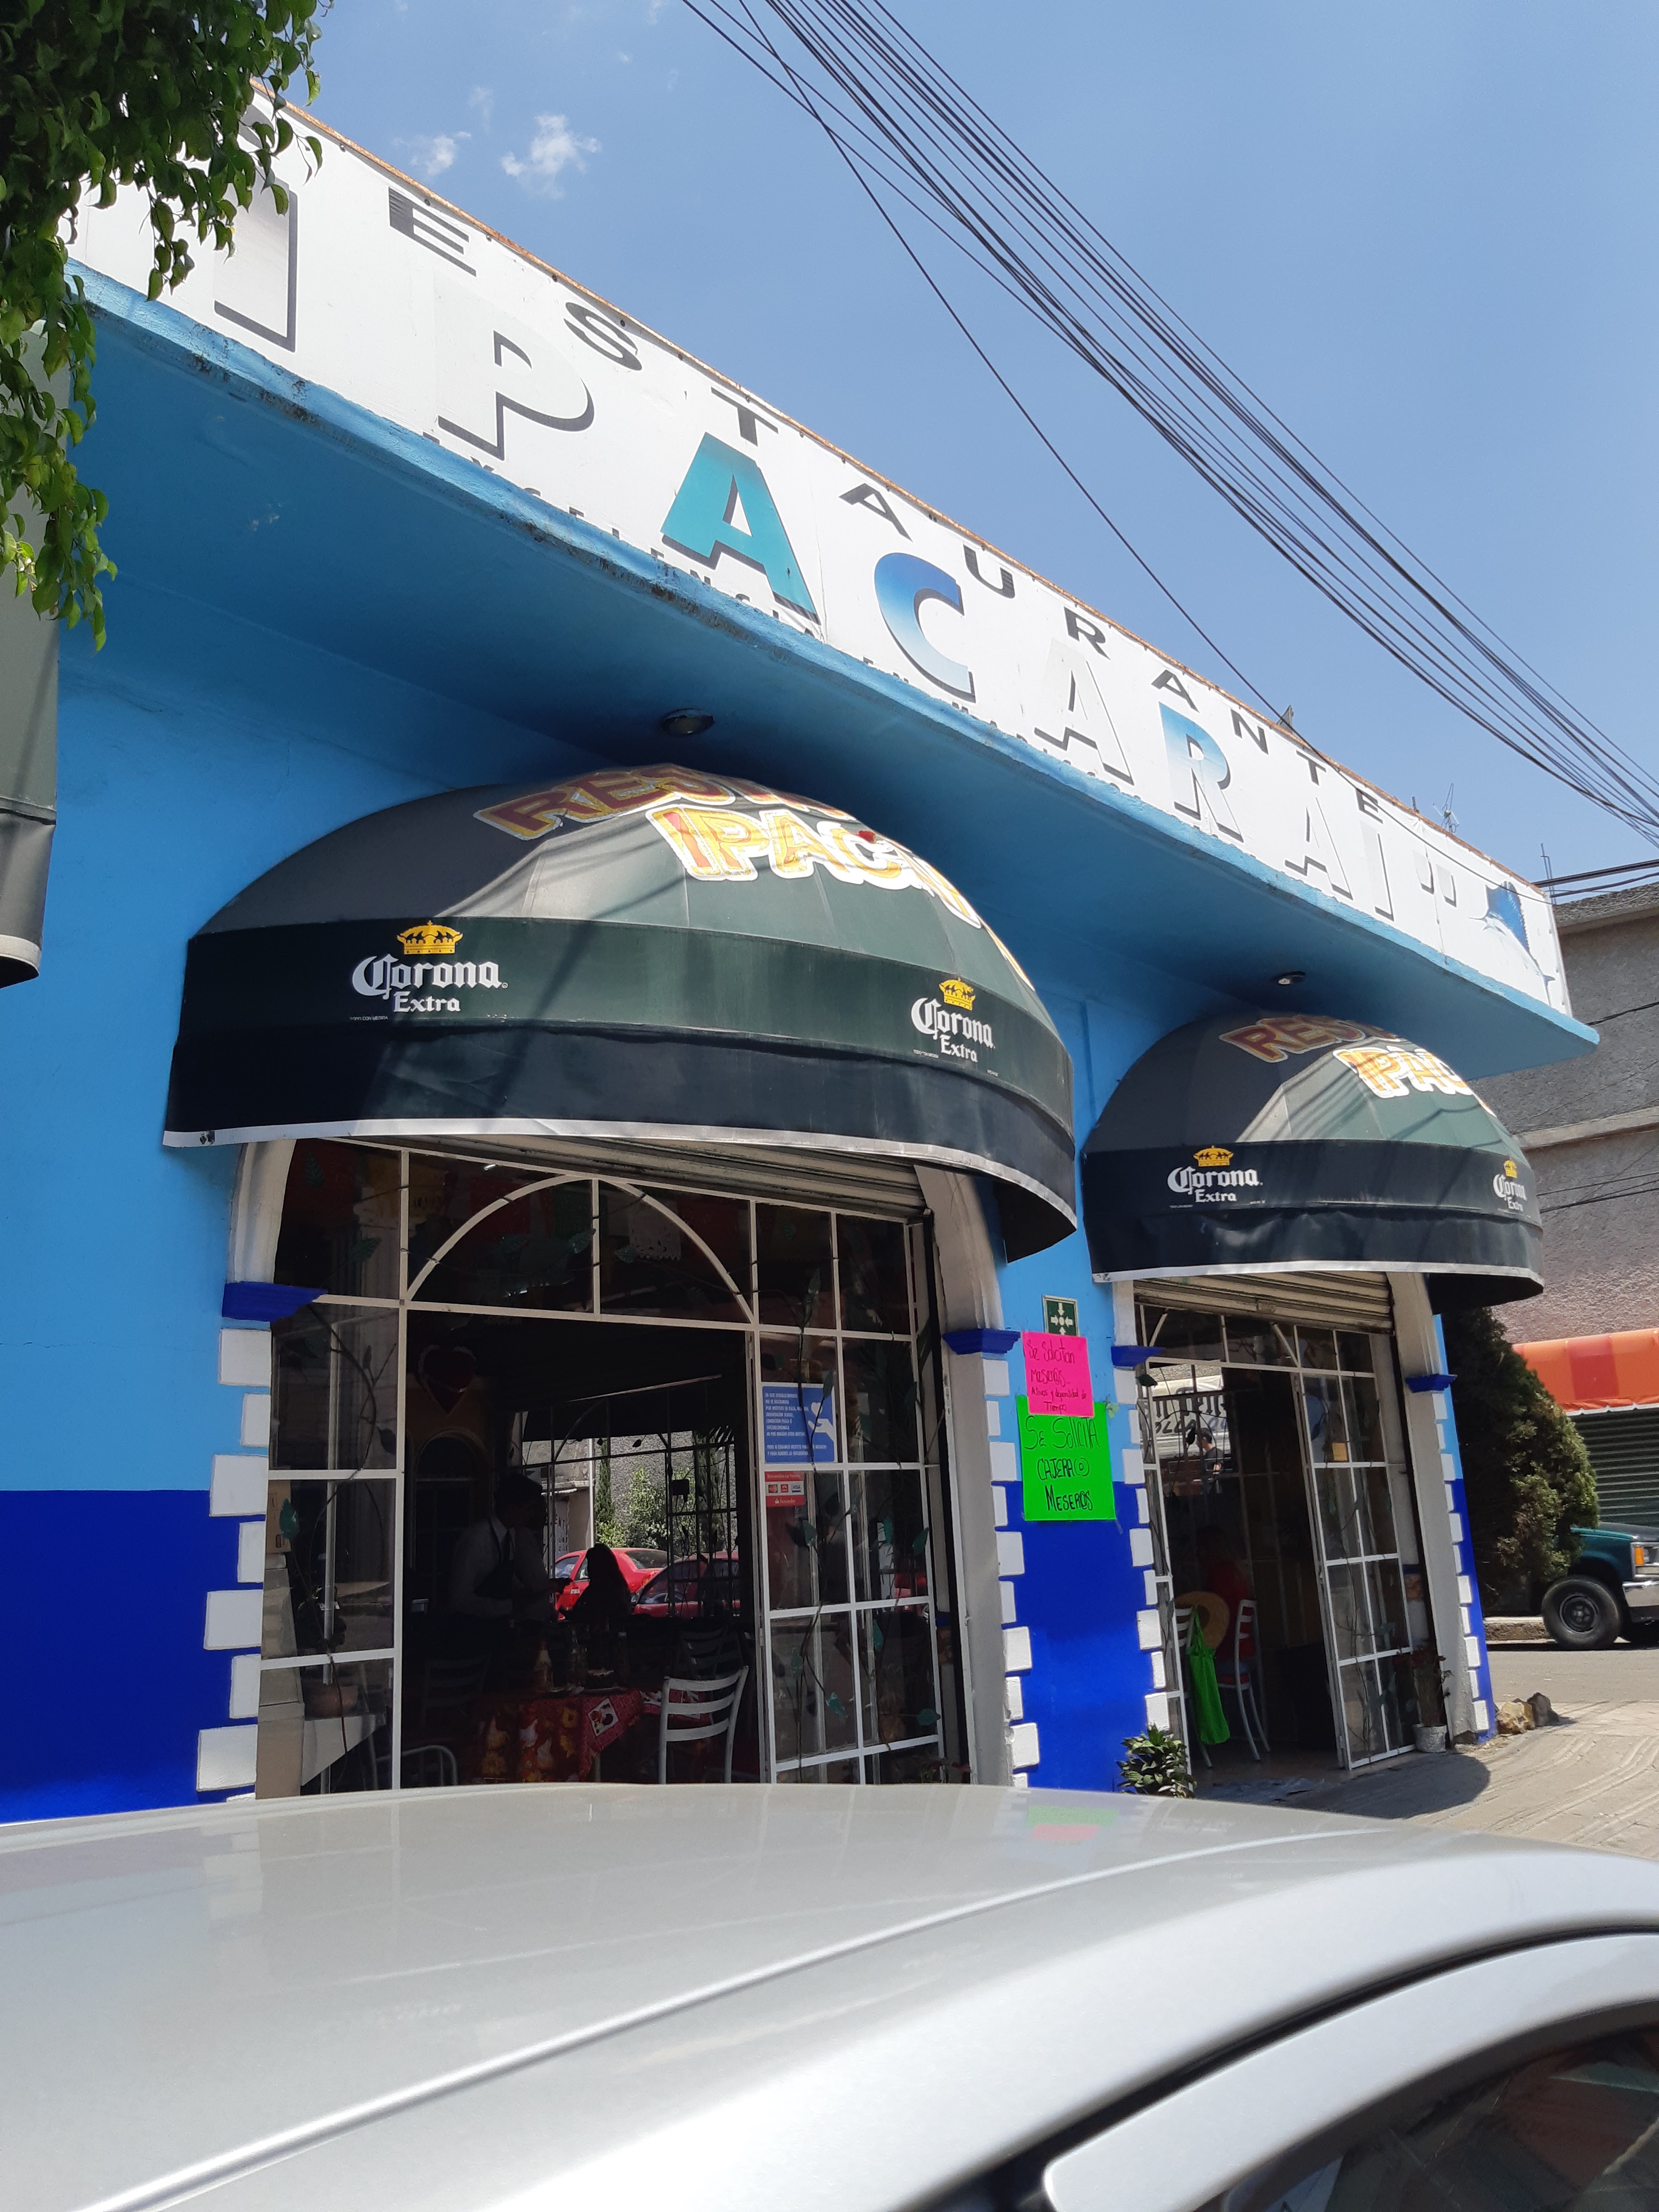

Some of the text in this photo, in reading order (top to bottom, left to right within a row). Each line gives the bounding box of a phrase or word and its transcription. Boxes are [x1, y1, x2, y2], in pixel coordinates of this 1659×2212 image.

[239, 103, 1383, 824] ESTAURANTE
[352, 954, 502, 999] Corona
[393, 991, 461, 1012] Extra
[911, 998, 995, 1048] Corona
[939, 1034, 978, 1062] Extra
[1167, 1166, 1260, 1194] Corona
[1195, 1189, 1237, 1202] Extra
